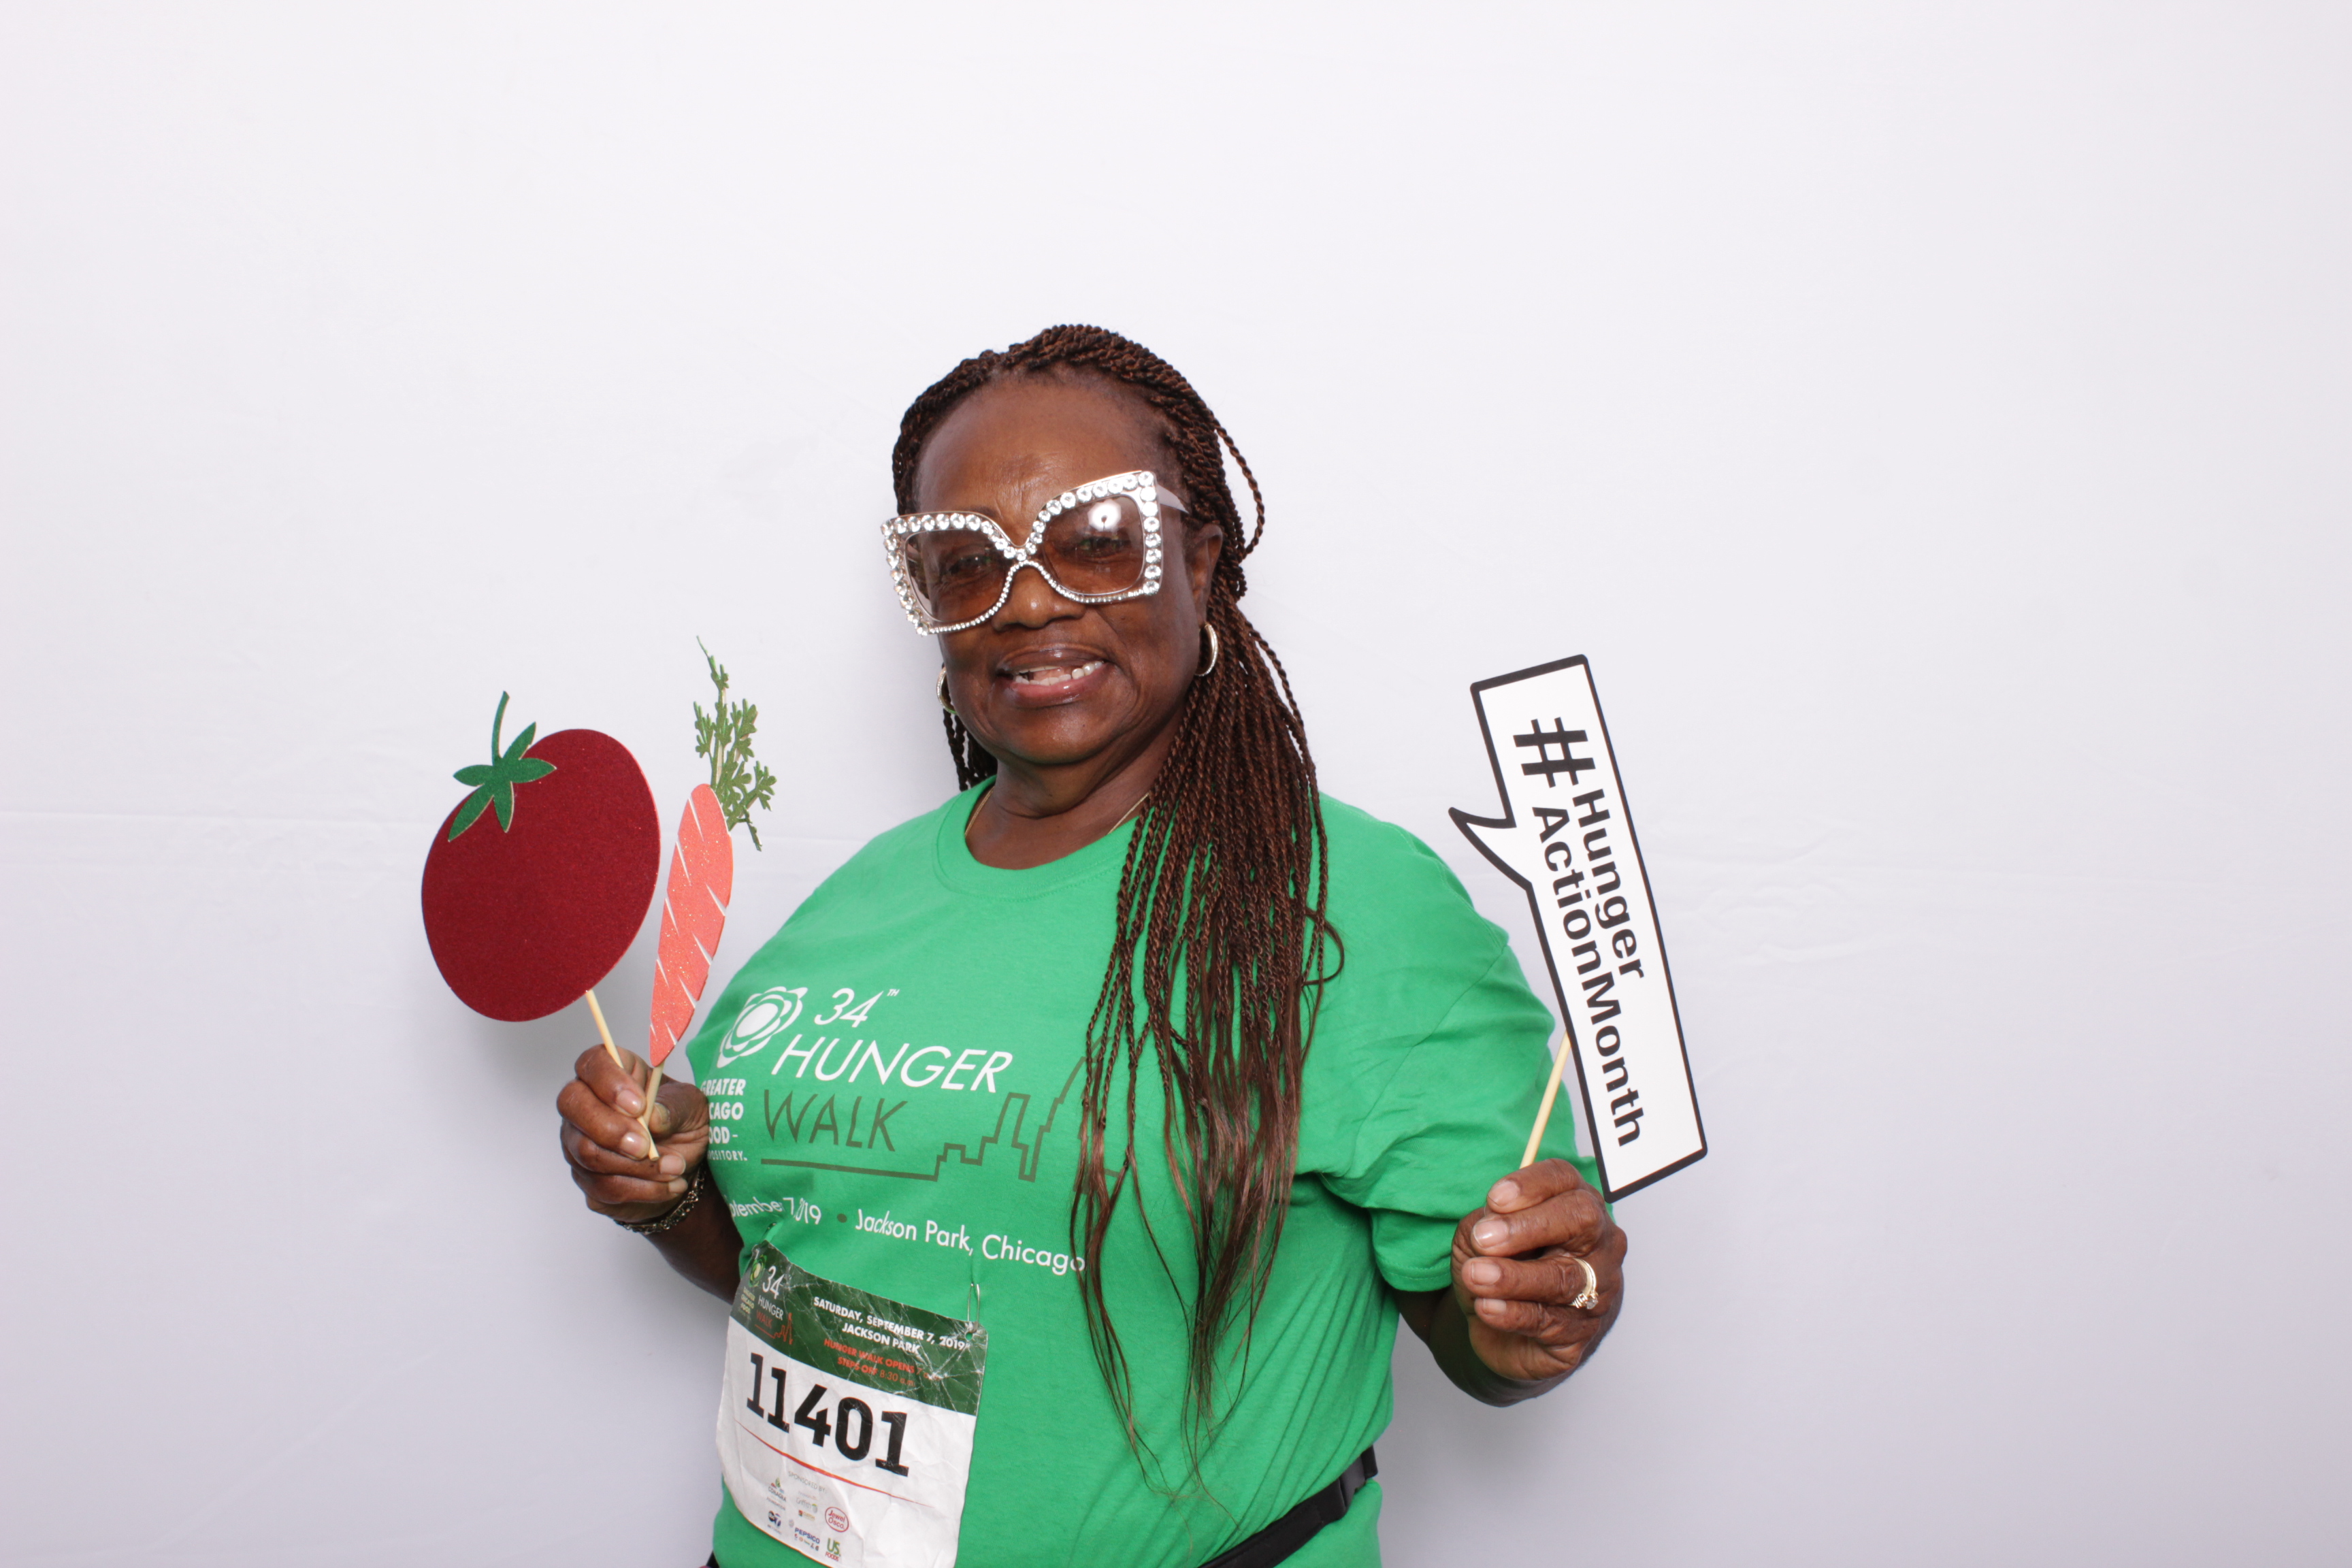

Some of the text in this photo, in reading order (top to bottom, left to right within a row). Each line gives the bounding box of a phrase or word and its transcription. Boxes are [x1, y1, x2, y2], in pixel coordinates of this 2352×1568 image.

[1532, 806, 1644, 1147] ActionMonth
[770, 1033, 1013, 1093] HUNGER
[708, 1102, 744, 1120] CAGO
[764, 1089, 909, 1152] WALK
[855, 1209, 1085, 1276] Jackson Park, Chicago
[762, 1265, 785, 1300] 34
[756, 1309, 772, 1329] WALK
[757, 1295, 784, 1321] HUNGER
[813, 1296, 966, 1352] SATURDAY, SEPTEMBER 7, 2019
[842, 1322, 921, 1355] JACKSON PARK
[823, 1338, 858, 1356] HUNGER
[858, 1349, 884, 1365] WALK
[885, 1358, 915, 1374] OPENS
[879, 1369, 899, 1382] 8:30
[747, 1352, 910, 1477] 11401
[788, 1471, 818, 1490] SPONSORED
[828, 1509, 846, 1523] Jewel
[794, 1526, 821, 1545] PEPSICO
[825, 1550, 840, 1562] FOODS
